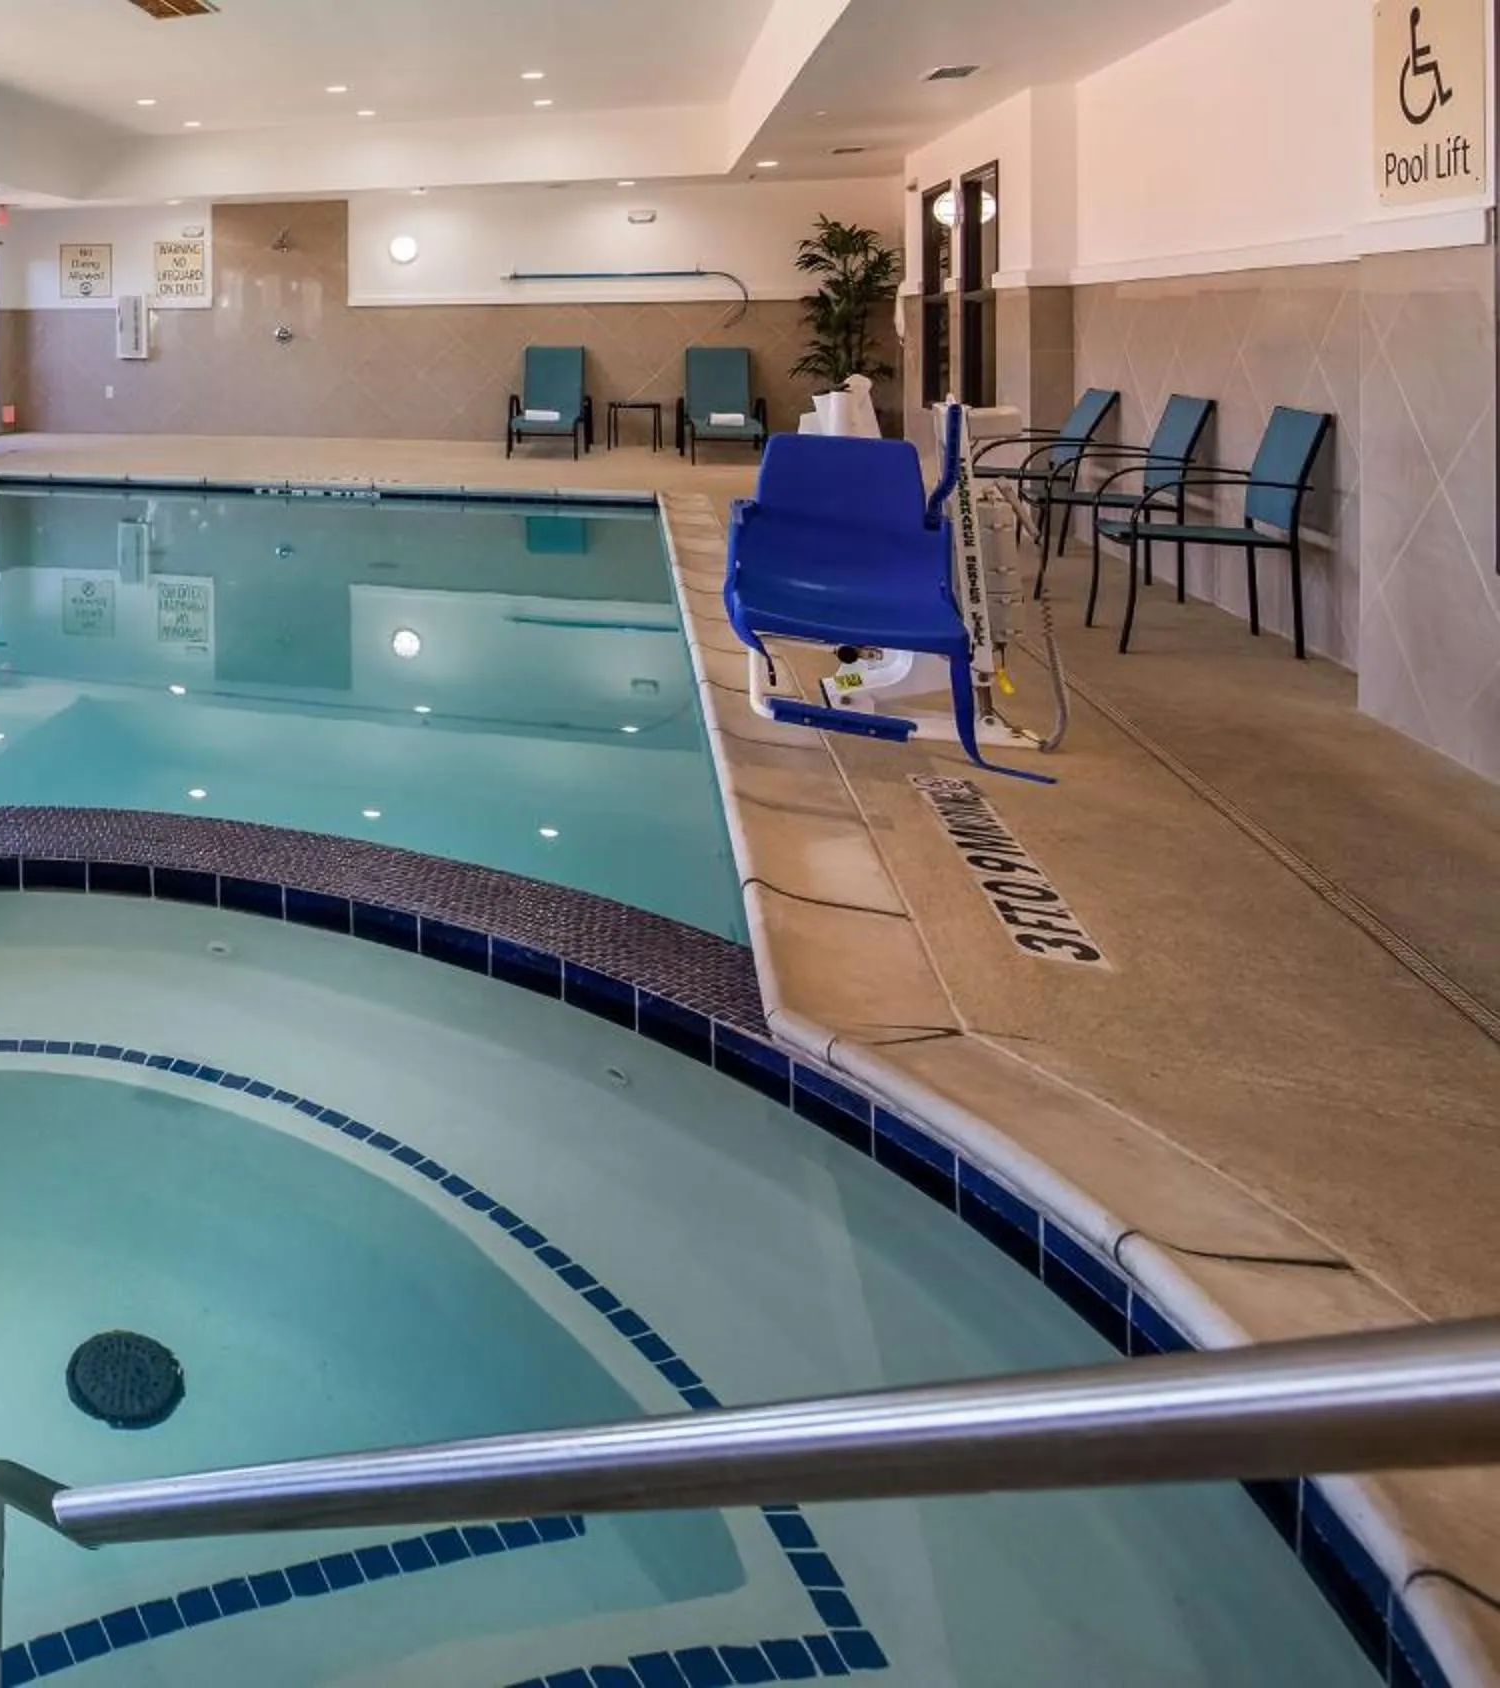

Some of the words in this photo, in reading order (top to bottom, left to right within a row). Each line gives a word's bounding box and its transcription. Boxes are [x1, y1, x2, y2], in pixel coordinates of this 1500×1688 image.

[1385, 143, 1429, 188] Pool
[1435, 135, 1471, 179] Lift
[159, 243, 201, 255] WARNING
[173, 256, 187, 268] NO
[68, 271, 105, 281] Allowed
[157, 269, 204, 281] LIFEGUARD
[160, 283, 173, 294] ON
[175, 283, 199, 294] DUTY
[1015, 933, 1101, 961] 3
